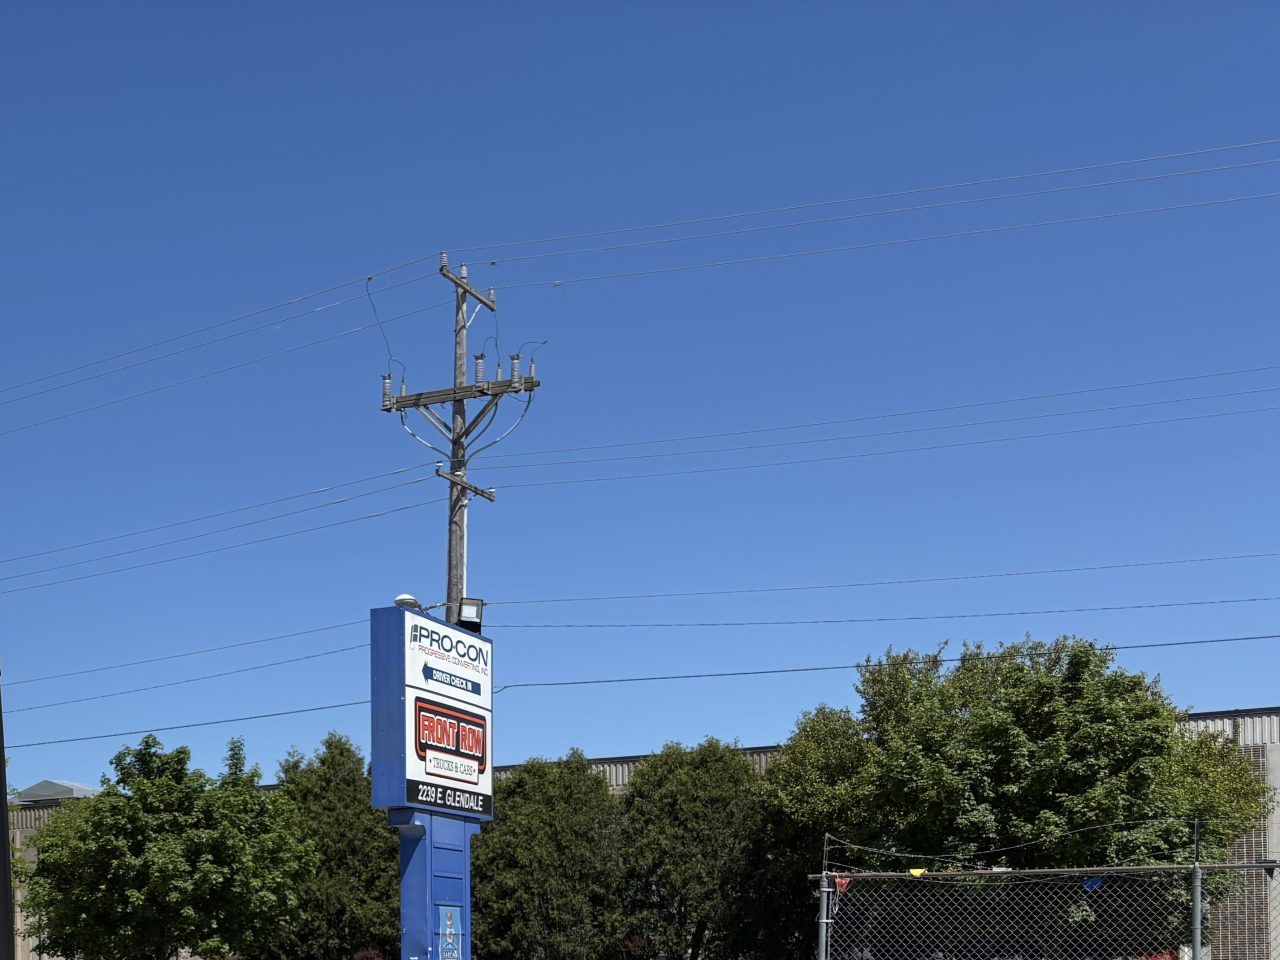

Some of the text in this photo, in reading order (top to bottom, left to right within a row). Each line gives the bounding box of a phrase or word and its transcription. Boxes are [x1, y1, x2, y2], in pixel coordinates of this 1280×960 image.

[432, 669, 473, 691] DRIVER CHECK IN
[420, 712, 483, 757] FRONT ROW
[432, 757, 454, 772] TRUCKS
[459, 763, 473, 776] CARS
[418, 784, 484, 811] 2239 E. GLENDALE
